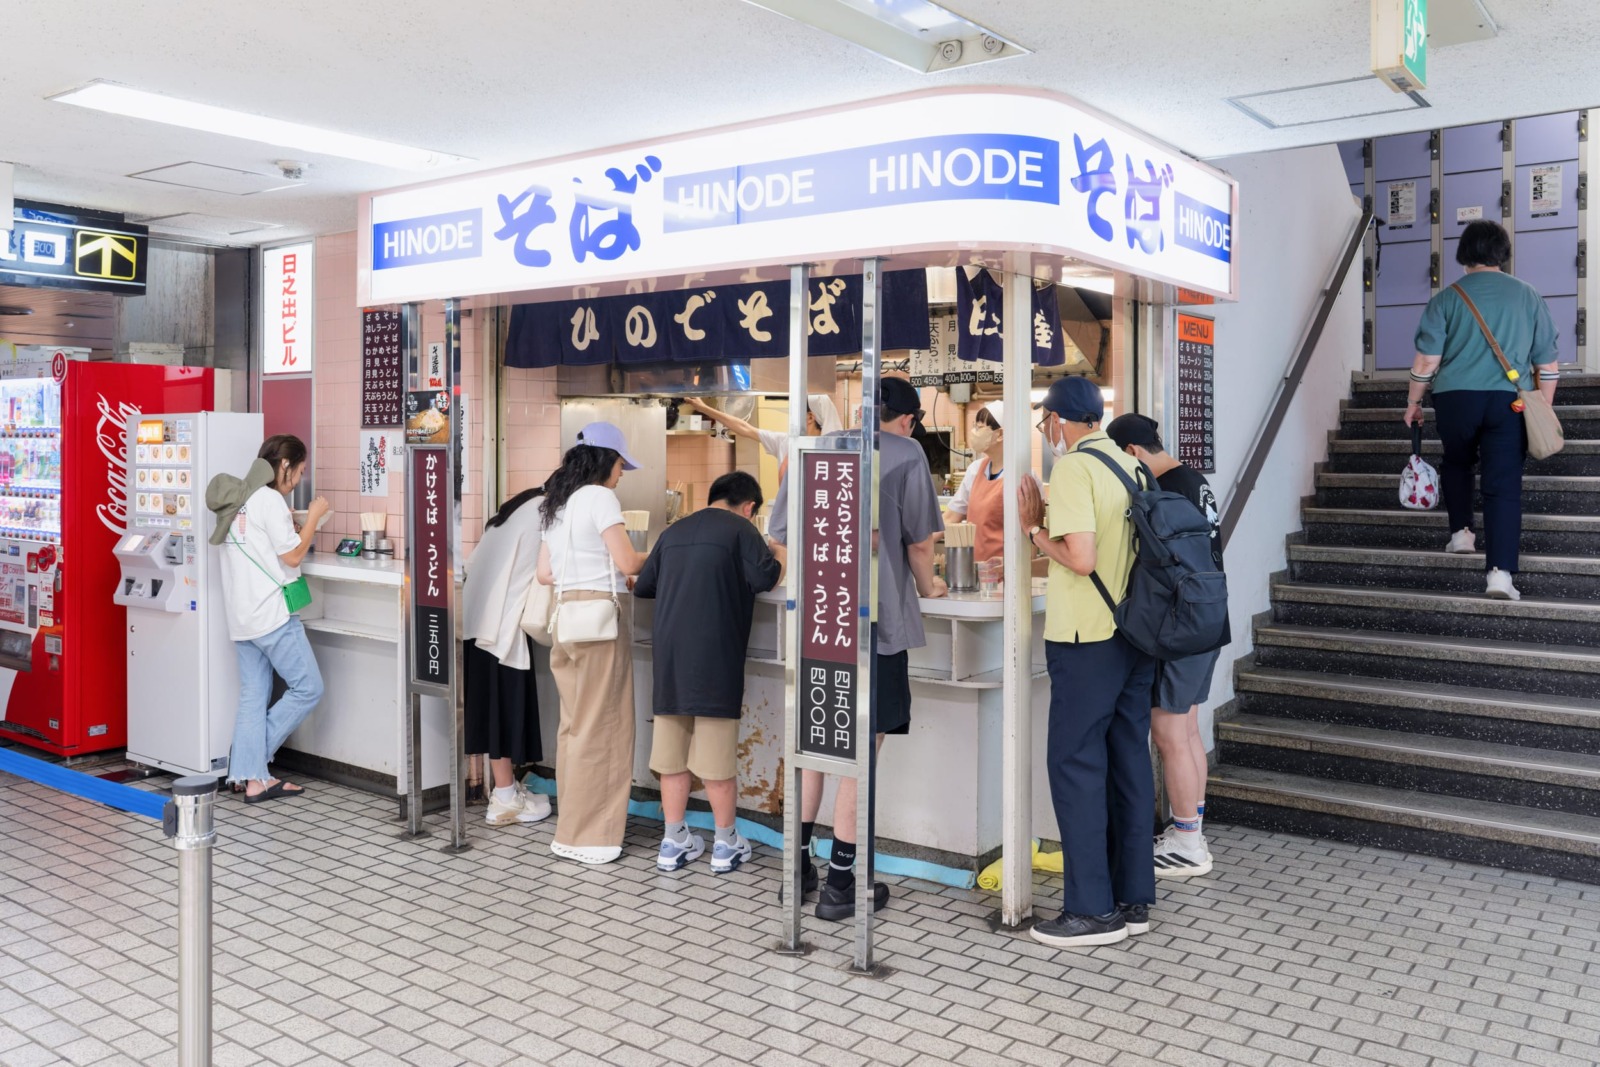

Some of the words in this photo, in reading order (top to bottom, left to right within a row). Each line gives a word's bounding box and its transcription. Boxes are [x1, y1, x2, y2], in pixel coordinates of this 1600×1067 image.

[869, 148, 1044, 194] HINODE
[493, 155, 663, 267] そば
[676, 169, 815, 219] HINODE
[1070, 132, 1174, 255] そば
[384, 220, 473, 259] HINODE
[1179, 204, 1231, 252] HINODE
[281, 253, 298, 367] 日之出ビル
[365, 323, 398, 333] 冷しラーメン
[570, 278, 846, 351] ひのでそば
[366, 333, 398, 345] かけそば
[948, 320, 957, 356] 月見
[1184, 321, 1209, 338] MENU
[365, 345, 398, 356] わかめそば
[365, 357, 398, 367] 月見そば
[365, 369, 398, 379] 月見うどん
[923, 376, 942, 386] 450円
[944, 373, 960, 383] 400円
[978, 372, 993, 382] 350円
[365, 403, 398, 413] 天玉うどん
[365, 414, 398, 424] 天玉そば
[425, 453, 439, 597] かけそば・うどん
[811, 461, 830, 645] 月見そば・うどん
[835, 462, 854, 648] 天ぷらそば・うどん
